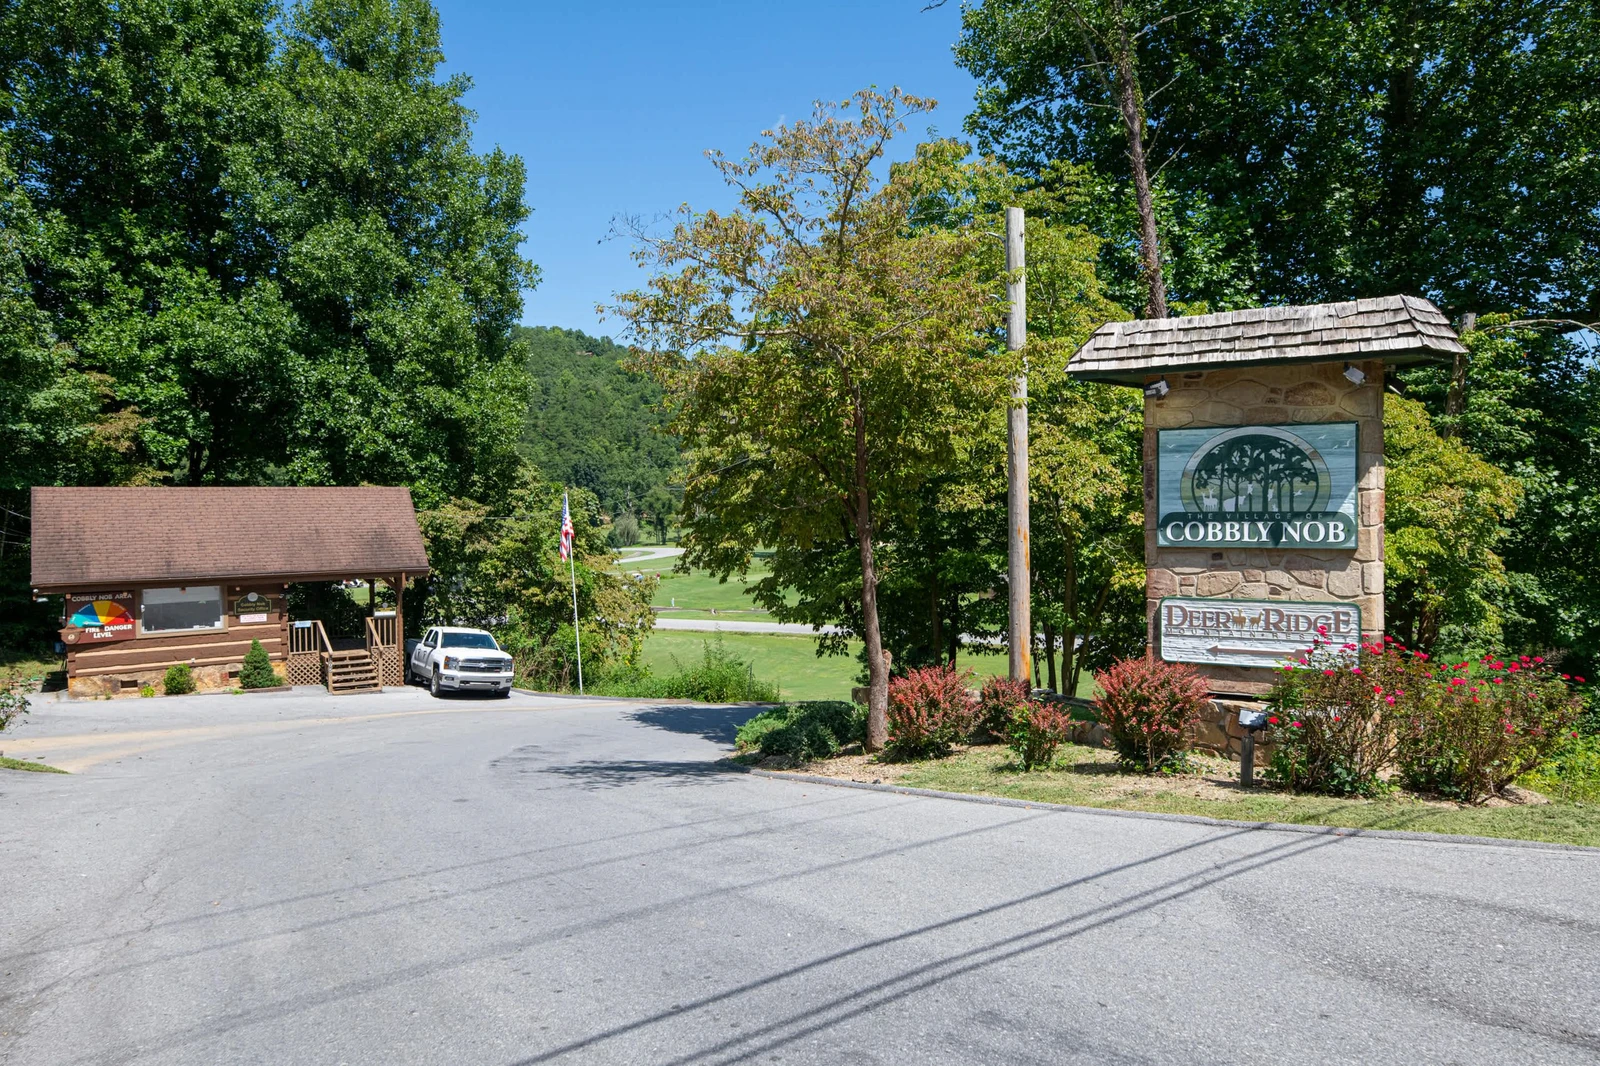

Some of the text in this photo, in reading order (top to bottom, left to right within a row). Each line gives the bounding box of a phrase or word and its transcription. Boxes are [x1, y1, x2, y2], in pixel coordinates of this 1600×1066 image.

[1166, 521, 1346, 543] COBBLY NOB
[1165, 627, 1256, 637] MOUNTAIN
